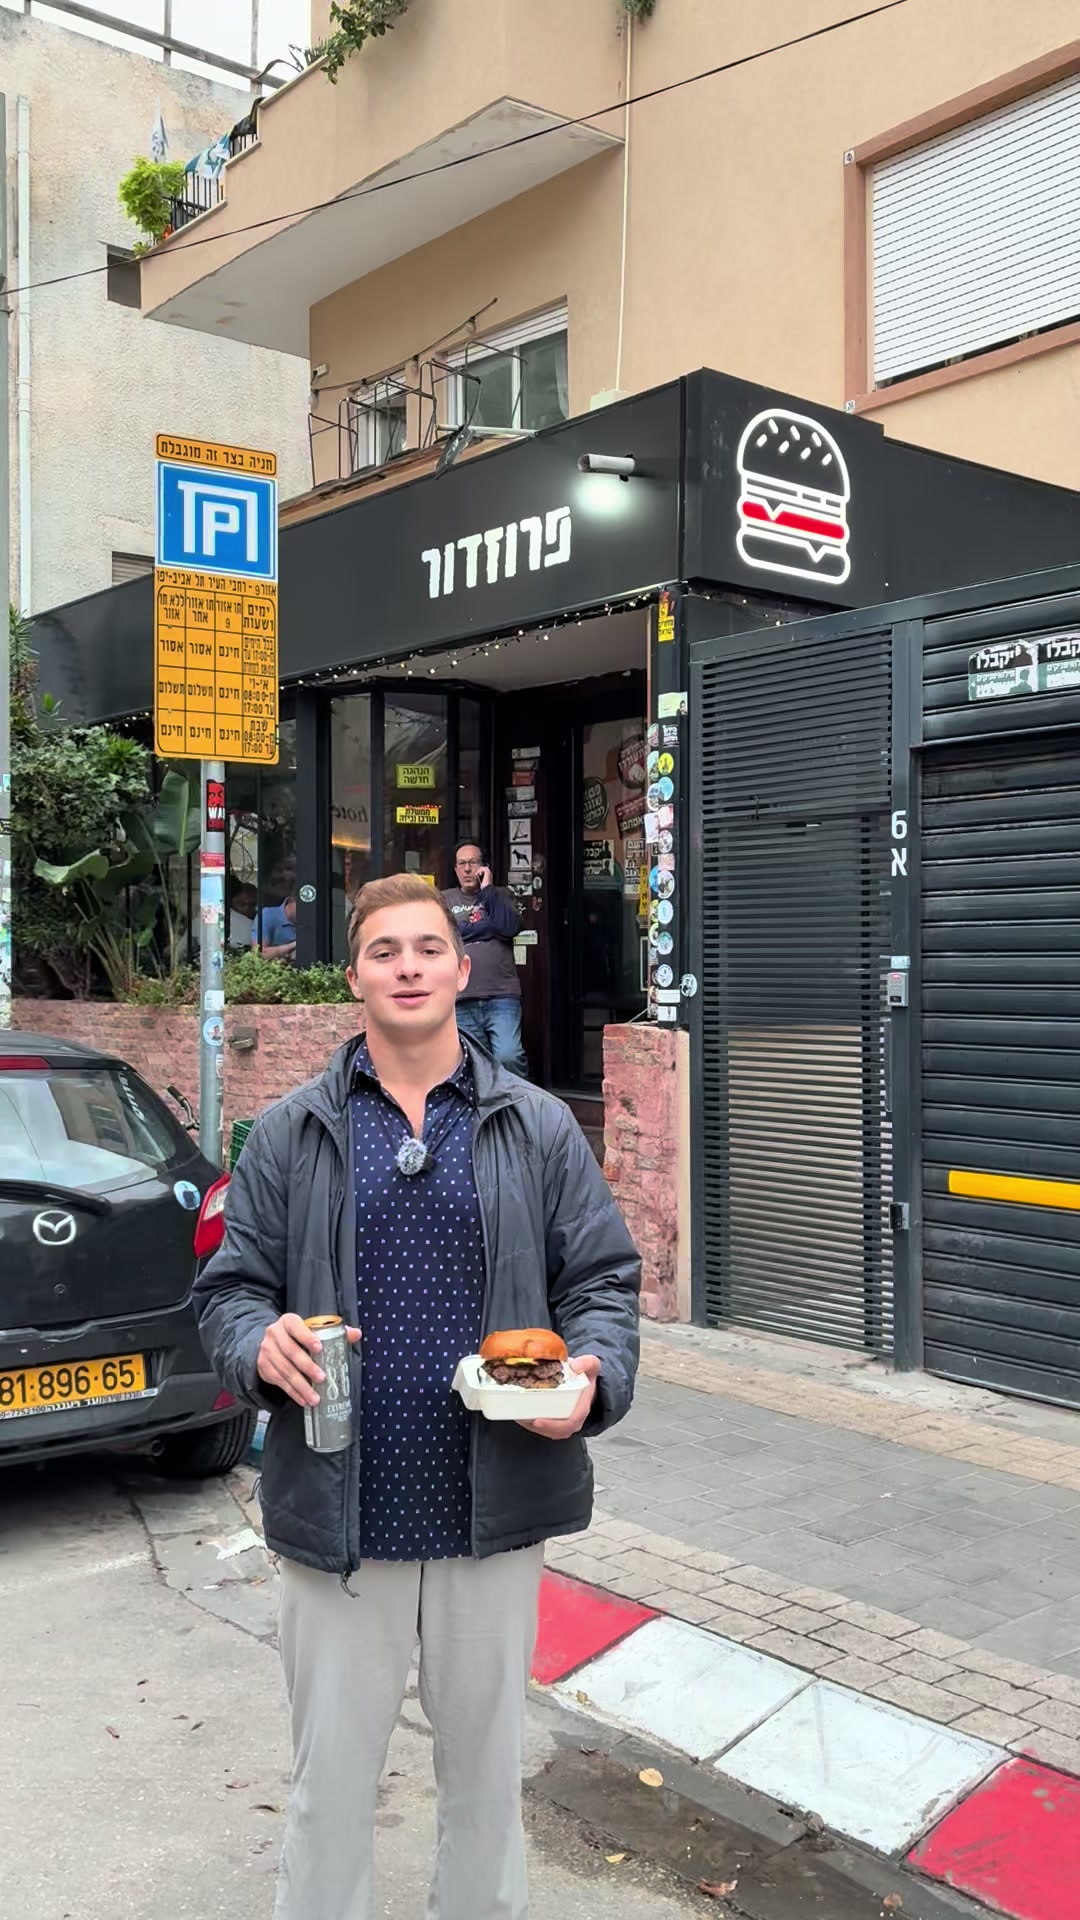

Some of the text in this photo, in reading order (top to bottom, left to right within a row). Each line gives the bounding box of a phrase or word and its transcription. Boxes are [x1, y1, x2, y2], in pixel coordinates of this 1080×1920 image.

[161, 439, 272, 471] חניה בצד זה מוגבלת
[421, 505, 572, 598] פרוזדור
[157, 570, 191, 586] אביב-יפו
[194, 574, 204, 587] תל
[208, 577, 226, 590] העיר
[160, 593, 184, 607] ללא תו
[187, 597, 213, 611] תו אזור
[164, 607, 180, 620] אזור
[217, 600, 241, 614] תו אזור
[248, 604, 270, 617] ימים
[192, 611, 208, 623] אחר
[225, 618, 230, 628] 9
[244, 617, 274, 630] ושעות
[160, 639, 183, 652] אסור
[189, 643, 212, 656] אסור
[219, 645, 239, 659] חינם
[159, 680, 185, 694] תשלום
[188, 684, 213, 698] תשלום
[219, 687, 239, 699] חינם
[244, 702, 263, 714] 17:00
[161, 724, 183, 737] חינם
[190, 726, 211, 739] חינם
[250, 720, 268, 732] שבת
[219, 728, 240, 741] חינם
[244, 742, 262, 754] 17:00
[403, 768, 430, 776] הנהגה
[404, 776, 429, 784] חדשה
[891, 810, 908, 840] 6
[891, 848, 908, 877] א
